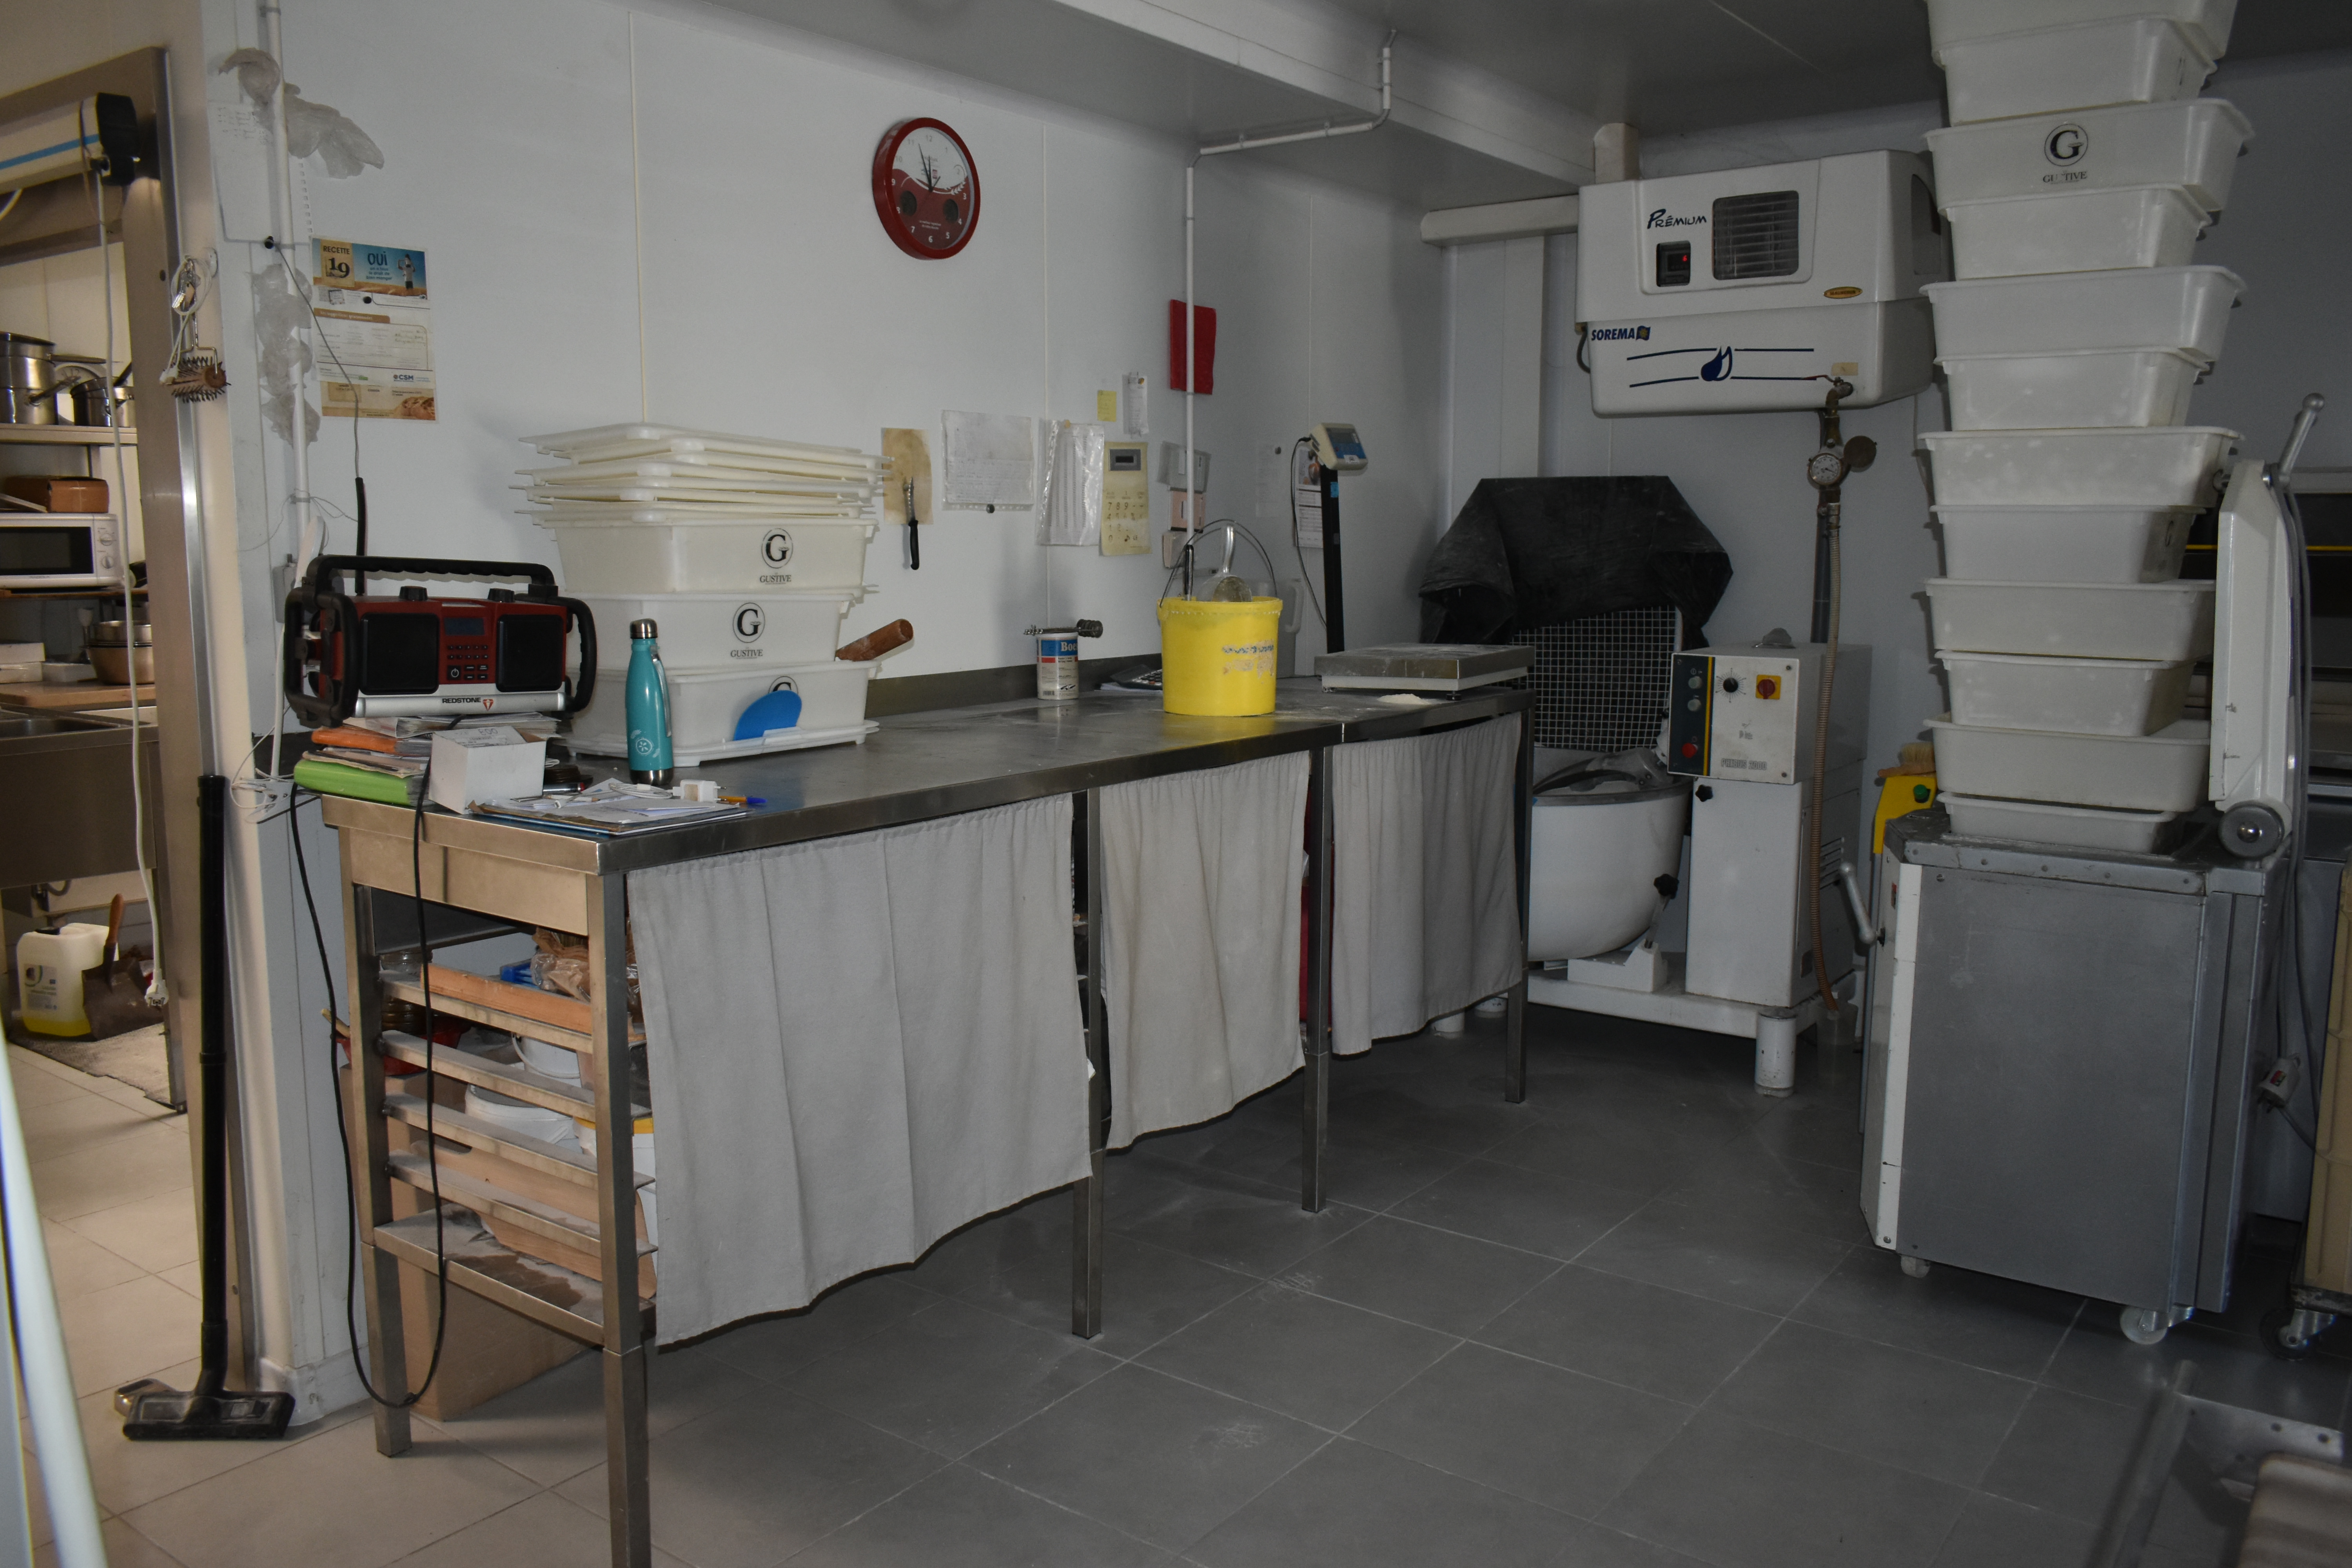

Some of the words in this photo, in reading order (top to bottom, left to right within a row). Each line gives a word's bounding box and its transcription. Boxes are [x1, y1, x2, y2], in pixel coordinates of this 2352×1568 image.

[2051, 130, 2083, 159] G
[2043, 171, 2087, 183] GUTIVE
[323, 245, 350, 255] RECETTE
[328, 257, 350, 278] 19
[1591, 328, 1635, 341] SOREMA
[1116, 502, 1120, 510] 8
[766, 534, 789, 562] G
[760, 575, 792, 583] GUSTIVE
[737, 608, 762, 637] G
[730, 649, 763, 657] GUSTIVE
[1721, 758, 1747, 769] PHEBUS
[1748, 760, 1767, 770] 2000
